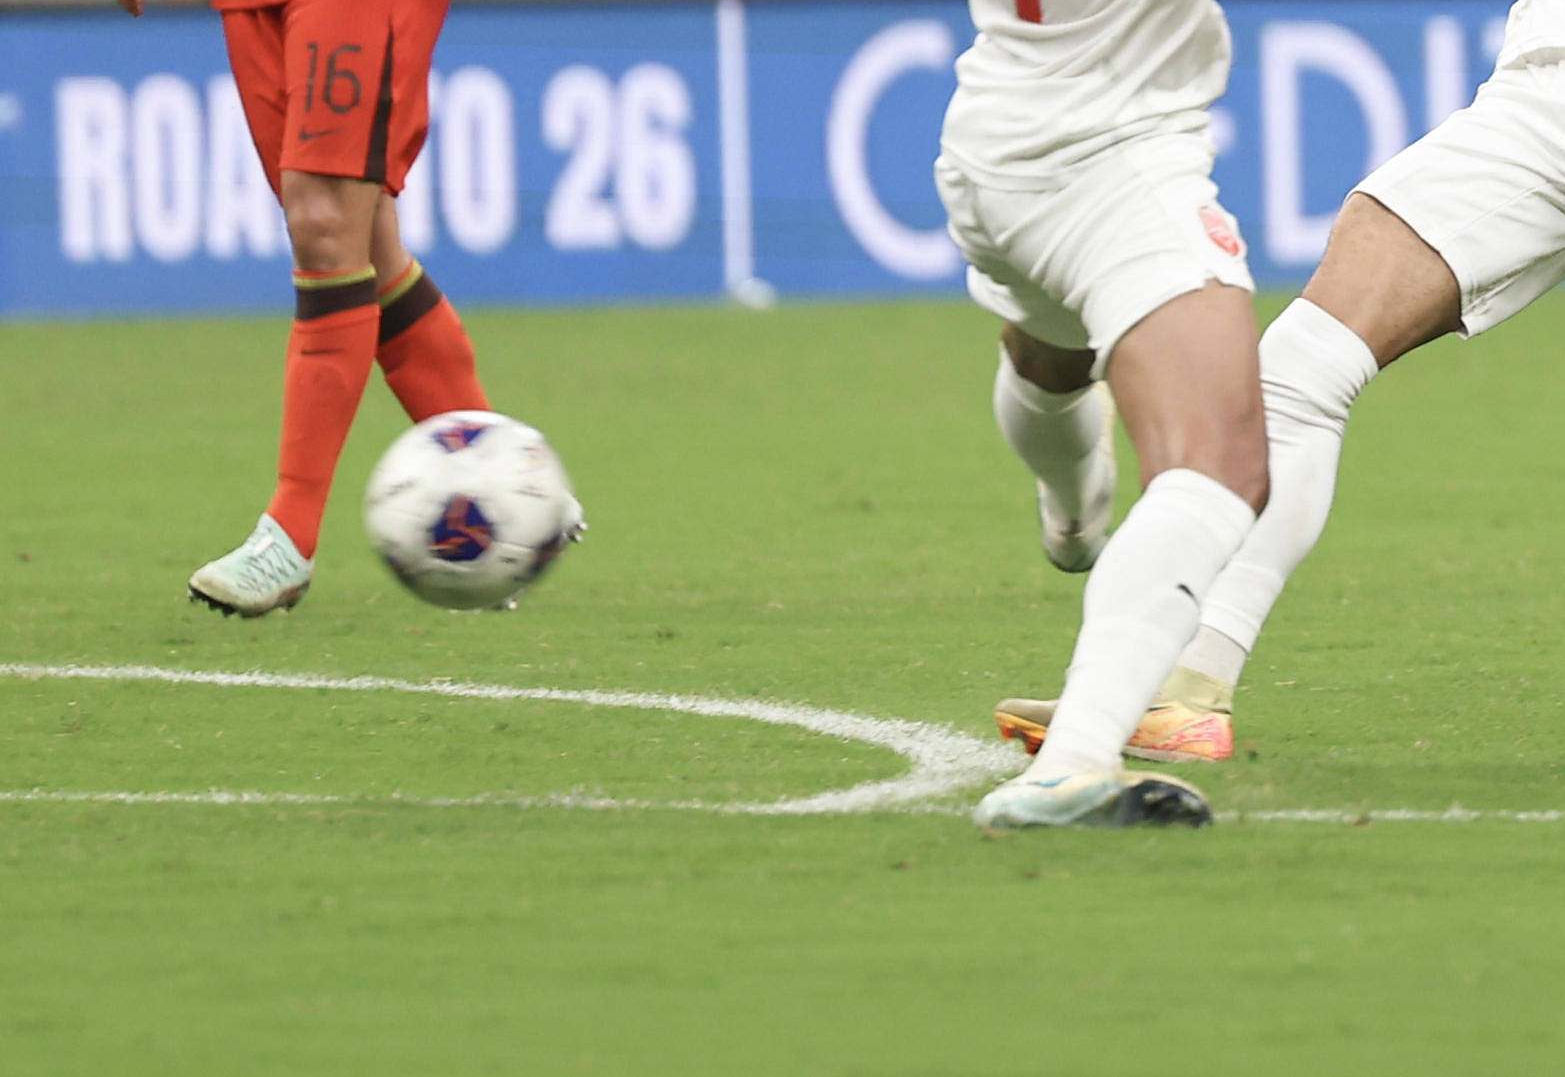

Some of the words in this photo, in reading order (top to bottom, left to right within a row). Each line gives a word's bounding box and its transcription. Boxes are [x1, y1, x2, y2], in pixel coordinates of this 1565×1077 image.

[304, 42, 363, 115] 16
[57, 74, 296, 262] ROA
[541, 62, 698, 251] 26
